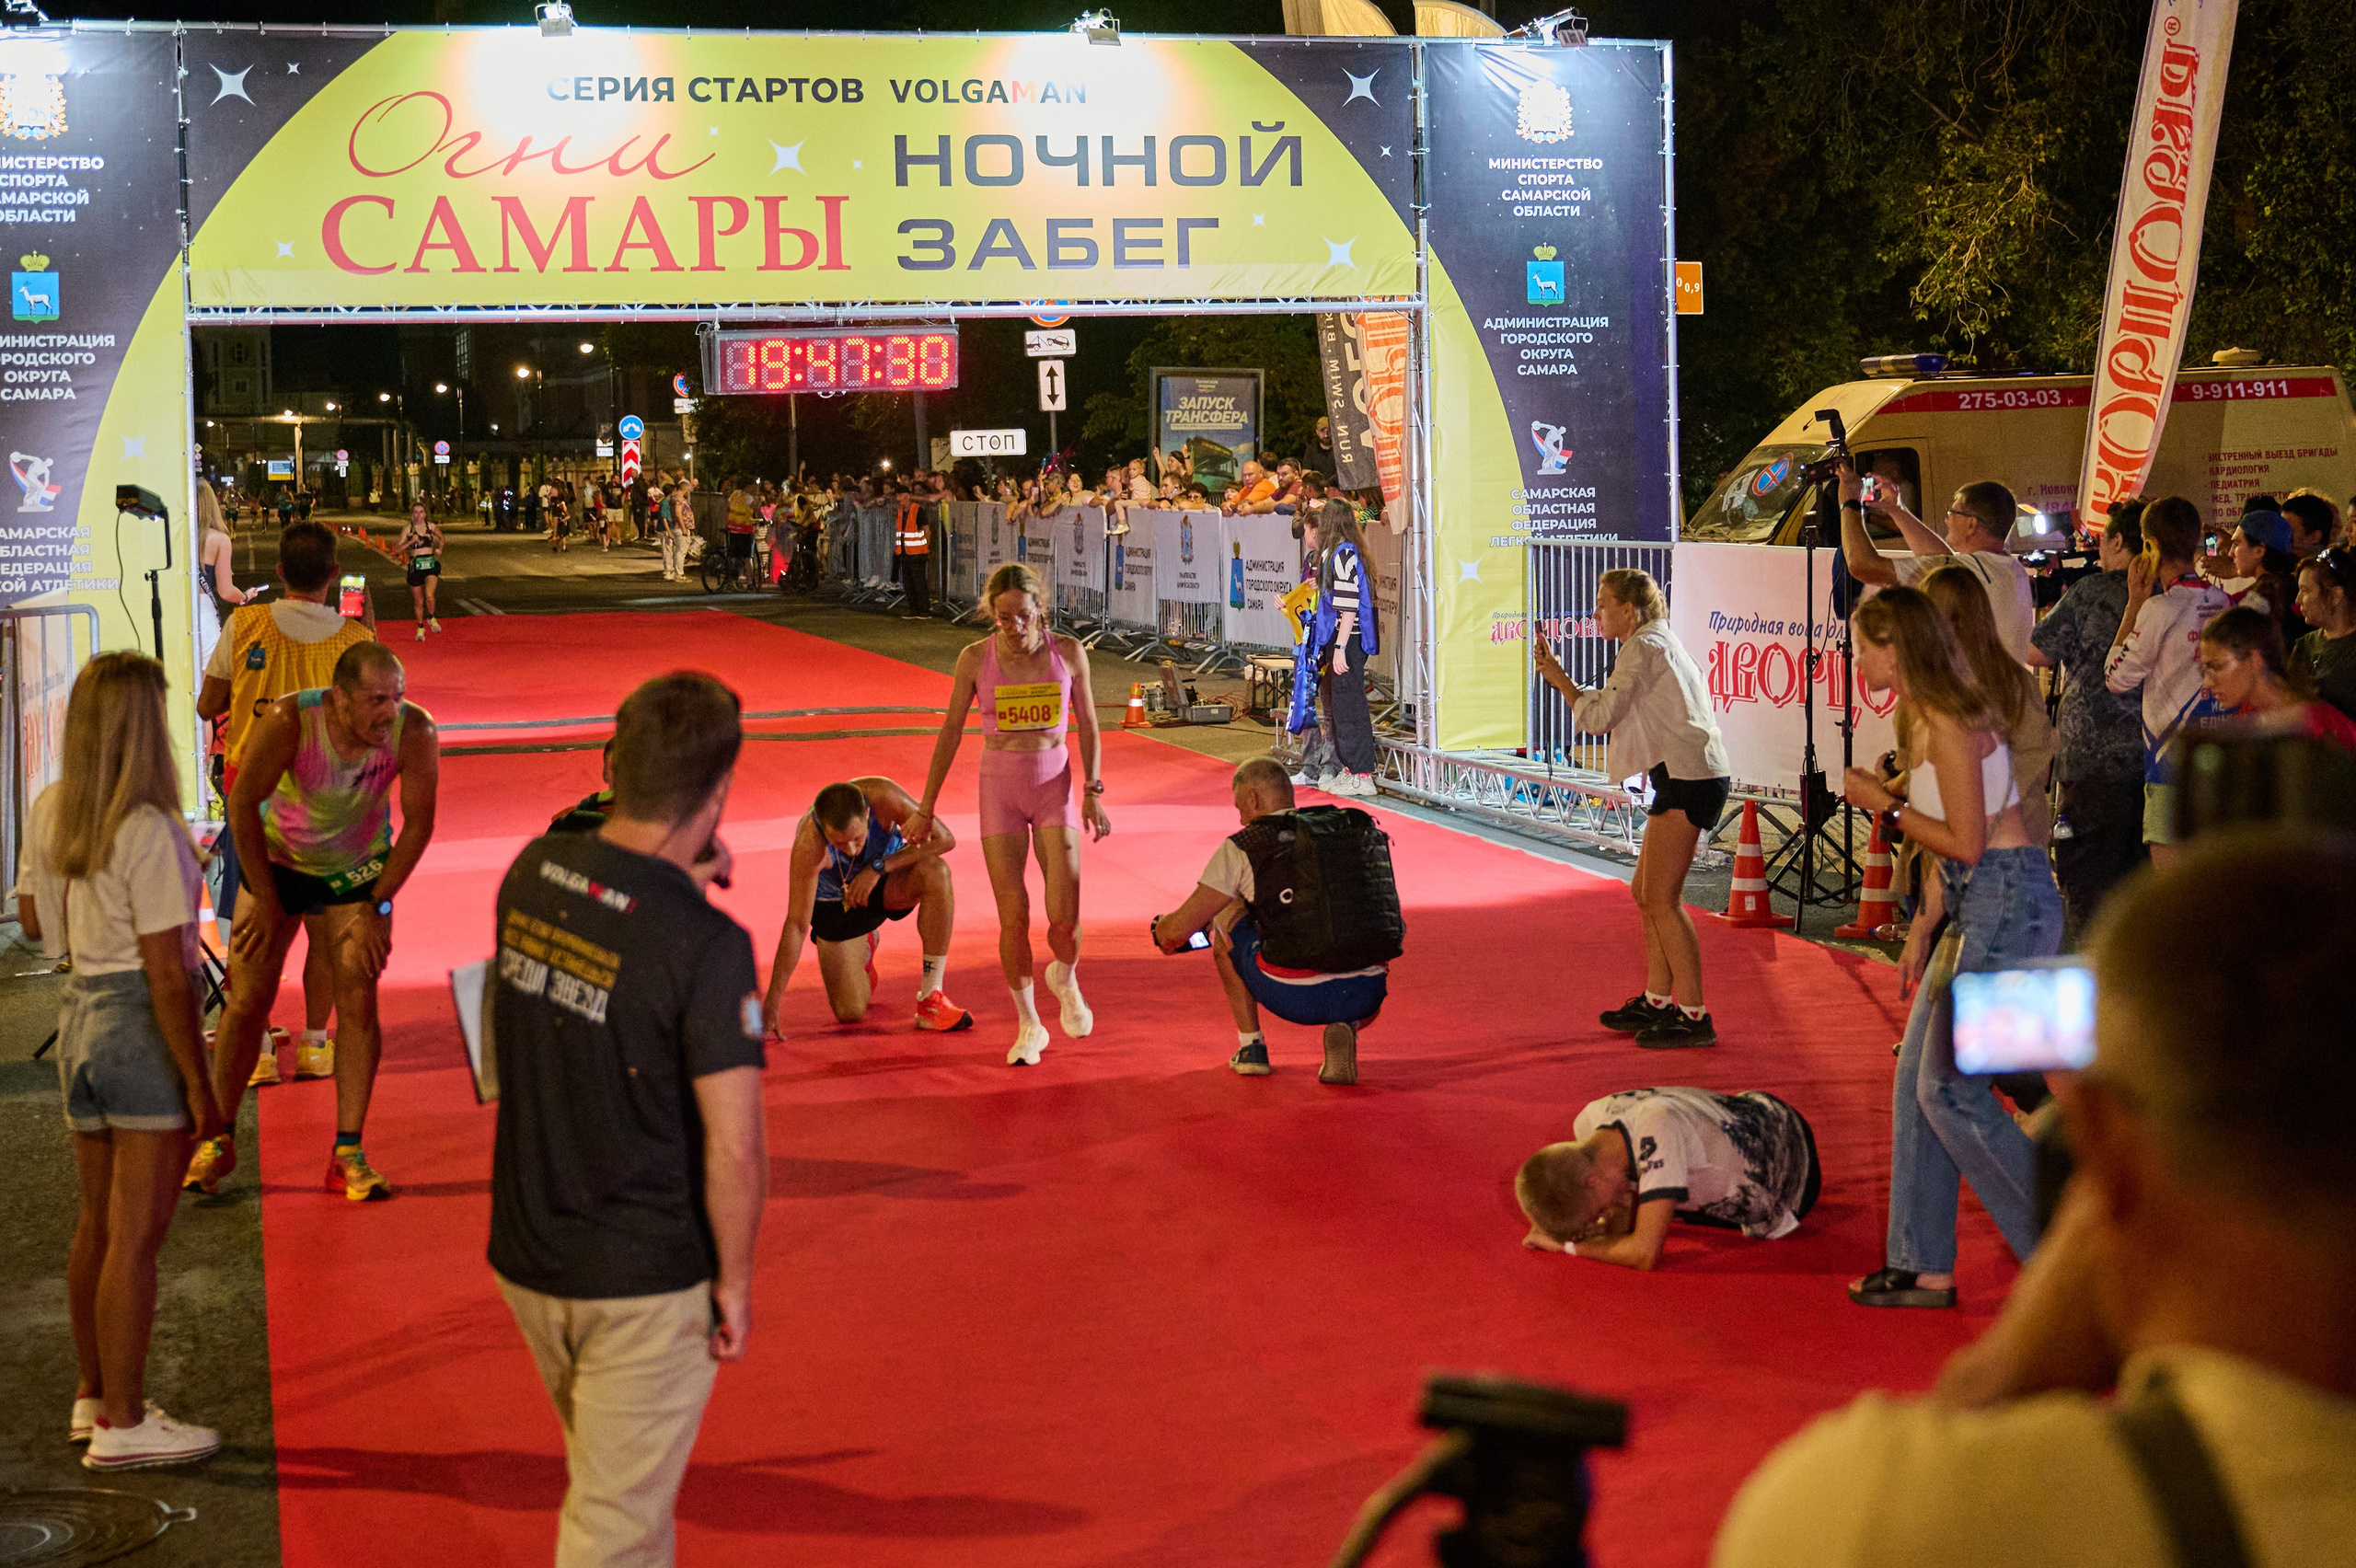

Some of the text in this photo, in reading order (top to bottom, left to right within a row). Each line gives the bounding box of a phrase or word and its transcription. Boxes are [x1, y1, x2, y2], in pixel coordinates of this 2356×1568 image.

[547, 76, 864, 104] СЕРИЯ СТАРТОВ
[889, 79, 1087, 104] VOLGAMAN
[348, 90, 716, 179] Огни
[894, 121, 1303, 187] НОЧНОЙ
[0, 156, 105, 170] ИСТЕРСТВО
[1488, 157, 1603, 171] МИНИСТЕРСТВО
[1518, 173, 1575, 186] СПОРТА
[0, 189, 90, 205] МАРСКОЙ
[1501, 187, 1591, 202] САМАРСКОЙ
[1513, 204, 1580, 217] ОБЛАСТИ
[321, 194, 851, 276] САМАРЫ
[896, 217, 1219, 271] ЗАБЕГ
[1684, 282, 1701, 294] 0,9
[1483, 316, 1610, 330] АДМИНИСТРАЦИЯ
[1500, 332, 1594, 346] ГОРОДСКОГО
[0, 352, 96, 366] РОДСКОГО
[1519, 348, 1575, 361] ОКРУГА
[4, 369, 73, 383] ОКРУГА
[1517, 364, 1578, 376] САМАРА
[0, 387, 77, 401] САМАРА
[1958, 388, 2062, 409] 275-03-03
[1178, 396, 1236, 410] ЗАПУСК
[1164, 409, 1249, 424] ТРАНСФЕРА
[961, 433, 1016, 452] СТОП
[2265, 449, 2295, 459] ВЫЕЗД
[2297, 447, 2339, 458] БРИГАДЫ
[2211, 478, 2260, 490] ПЕДИАТРИЯ
[1510, 487, 1596, 500] САМАРСКАЯ
[2212, 493, 2233, 504] МЕД.
[1511, 502, 1596, 516] ОБЛАСТНАЯ
[1510, 518, 1597, 532] ФЕДЕРАЦИЯ
[1245, 559, 1285, 573] АДМИНИСТРАЦИЯ
[30, 578, 120, 593] АТЛЕТИКИ
[1247, 598, 1264, 610] САМАРА
[1708, 611, 1785, 636] Природная
[1008, 705, 1052, 724] 5408
